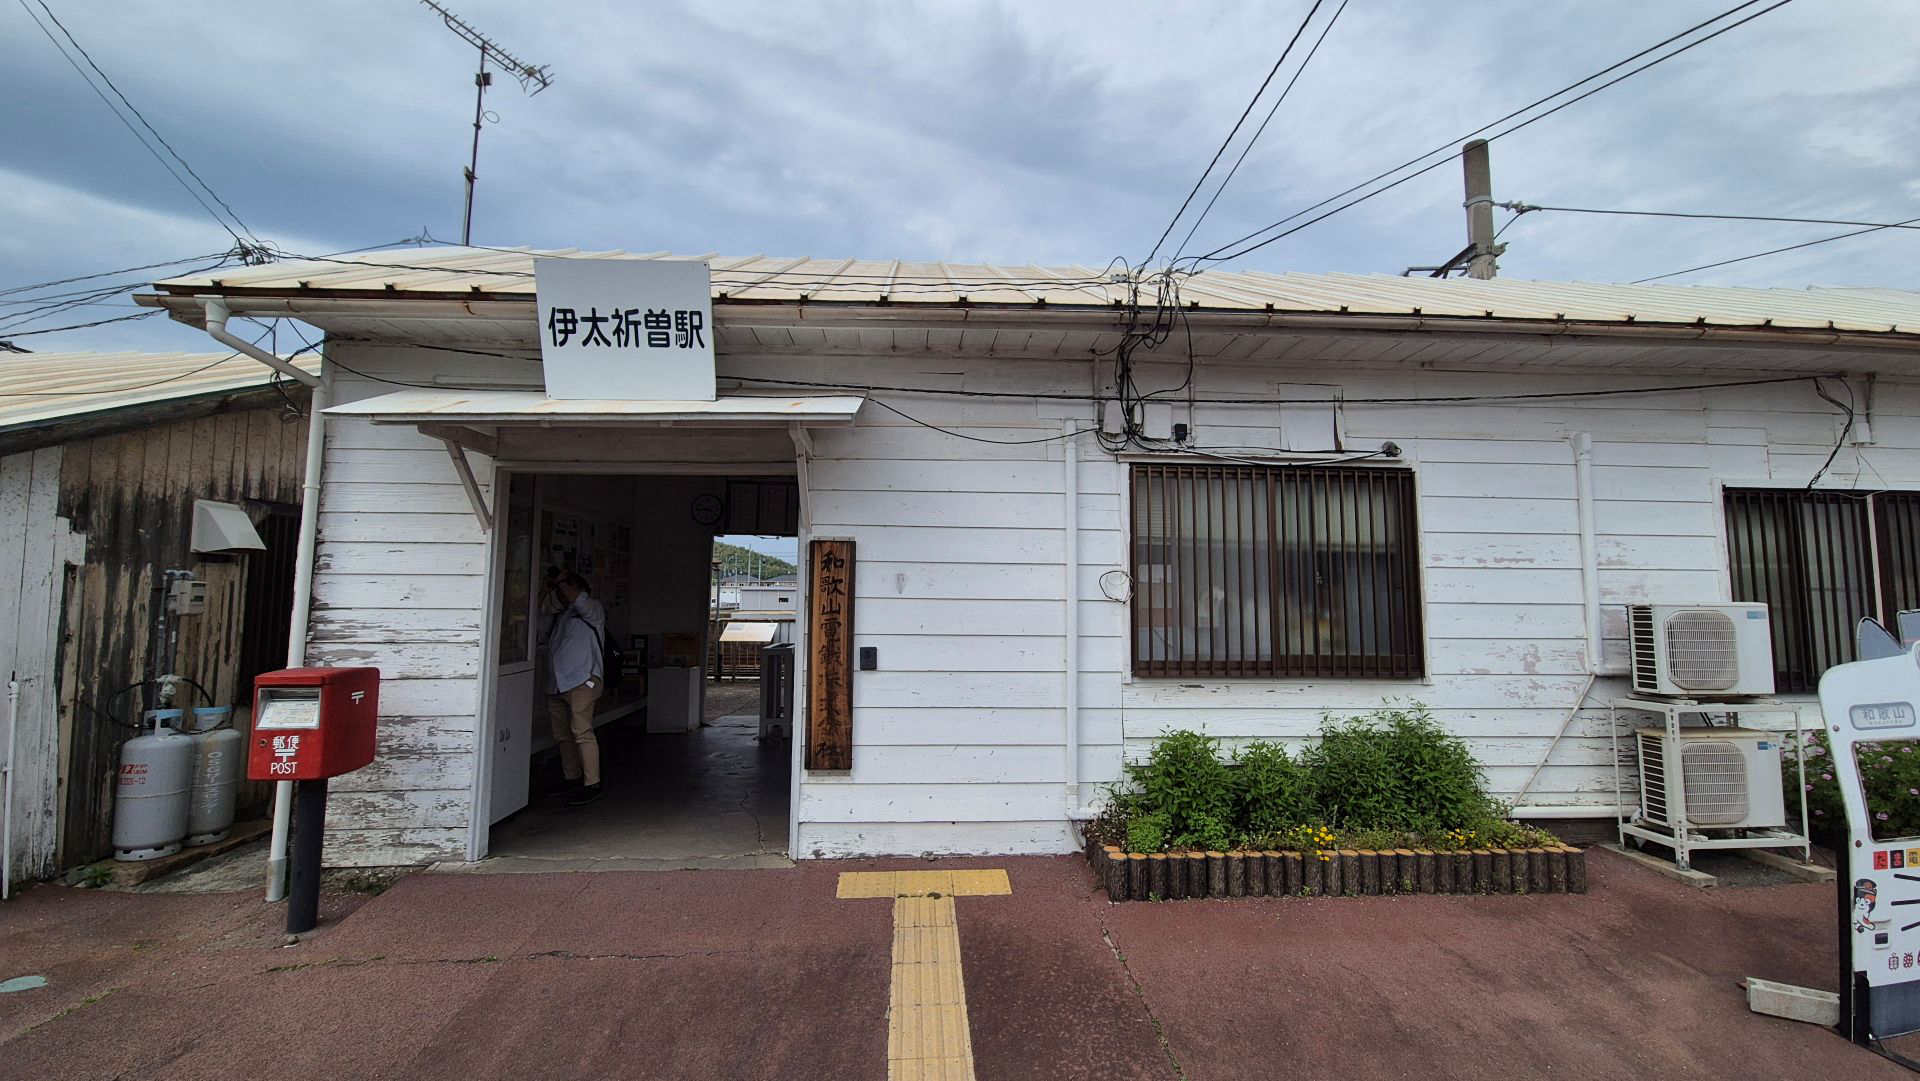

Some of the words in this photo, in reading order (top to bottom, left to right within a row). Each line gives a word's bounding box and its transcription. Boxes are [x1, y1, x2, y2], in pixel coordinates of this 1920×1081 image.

[548, 307, 705, 349] 伊太祈曽駅
[272, 735, 300, 750] 郵便
[270, 762, 298, 775] POST
